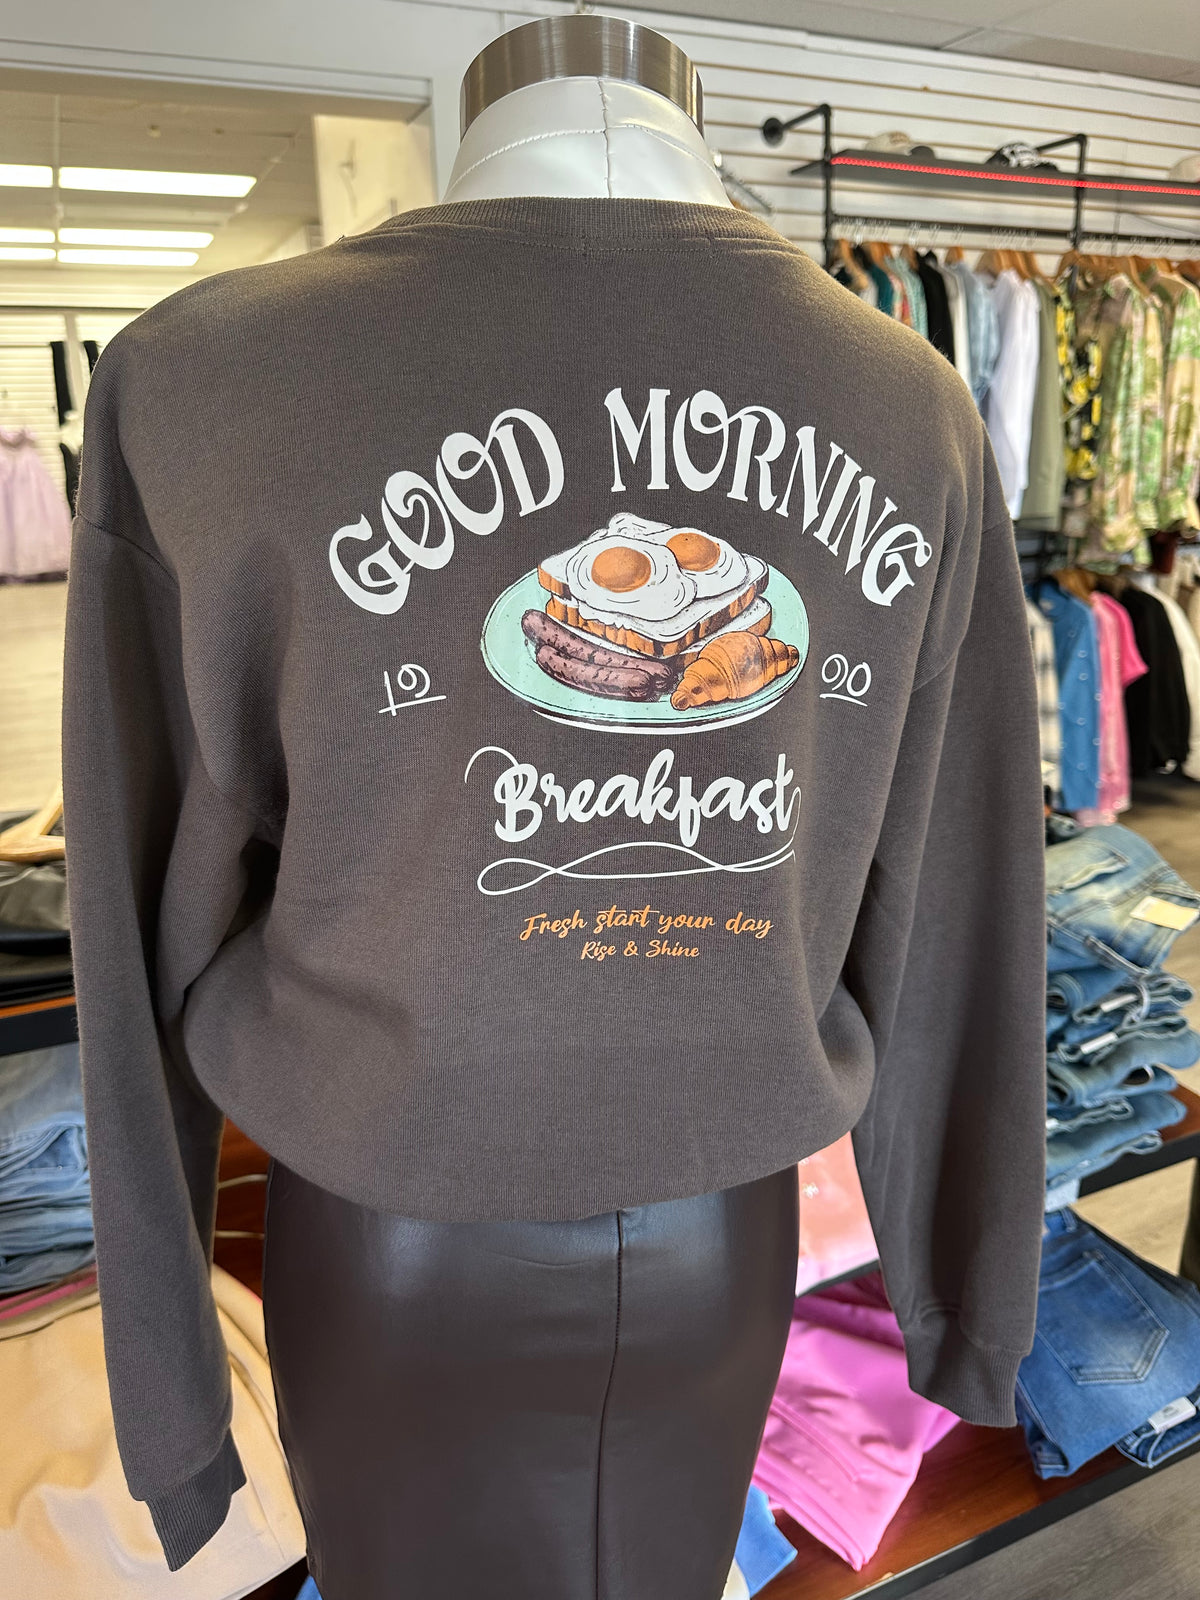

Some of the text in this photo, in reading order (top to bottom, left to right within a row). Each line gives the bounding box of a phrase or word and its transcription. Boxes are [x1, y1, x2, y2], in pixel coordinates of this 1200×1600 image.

[329, 388, 933, 616] GOOD MORNING
[383, 663, 431, 717] 19
[821, 653, 872, 697] 90
[487, 748, 800, 848] Breakfast
[519, 904, 774, 941] Fresh start your day
[580, 939, 701, 961] Rise & Shine
